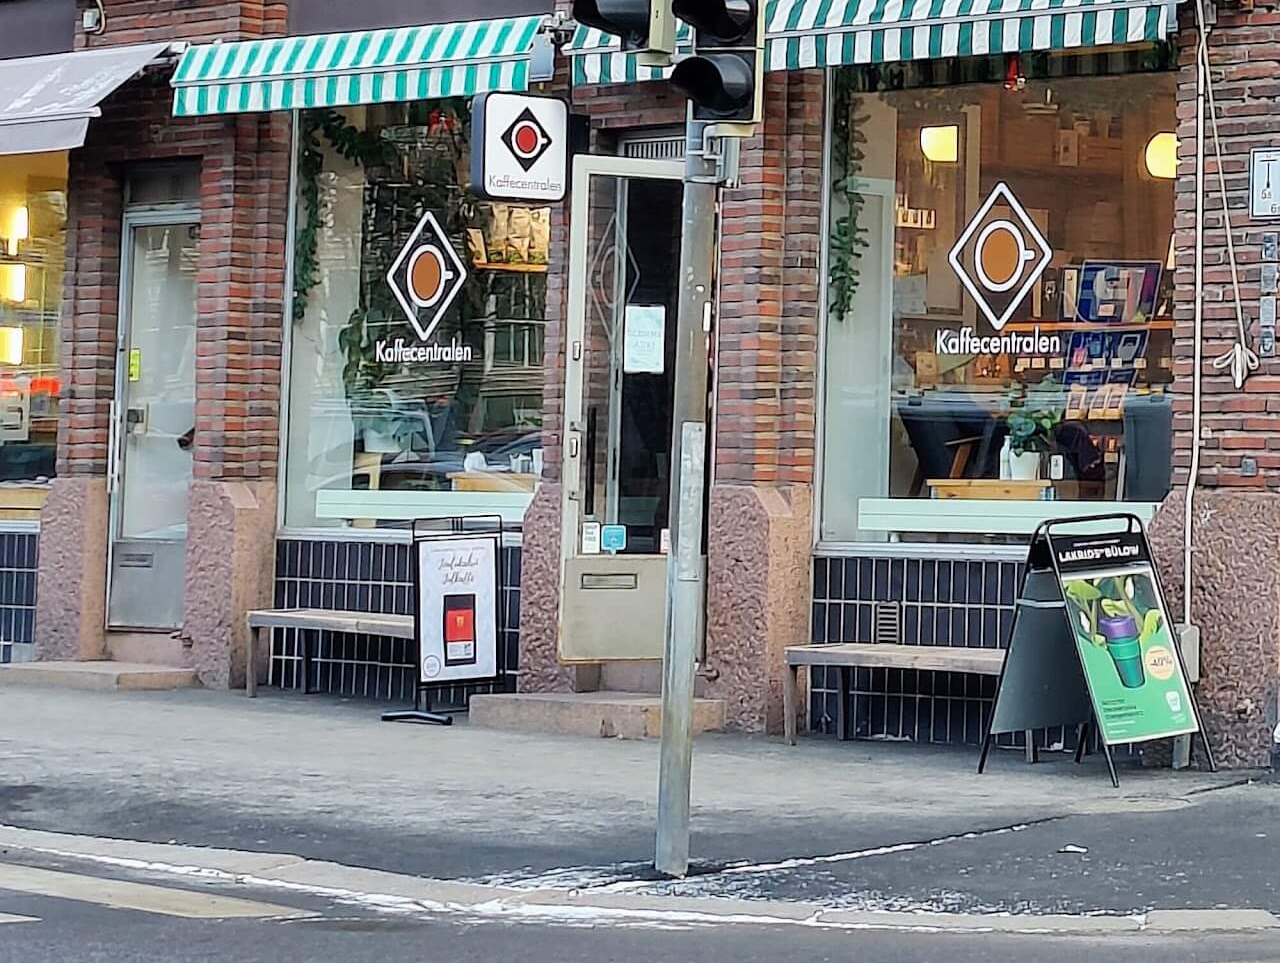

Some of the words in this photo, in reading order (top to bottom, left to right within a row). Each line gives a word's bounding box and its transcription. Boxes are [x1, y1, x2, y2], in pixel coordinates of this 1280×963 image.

[489, 174, 561, 191] Kaffecentralen
[375, 336, 472, 363] Kaffecentralen
[935, 325, 1060, 355] Kaffecentralen
[1059, 548, 1101, 563] LAKRIDS
[1104, 544, 1139, 558] BÜLOW
